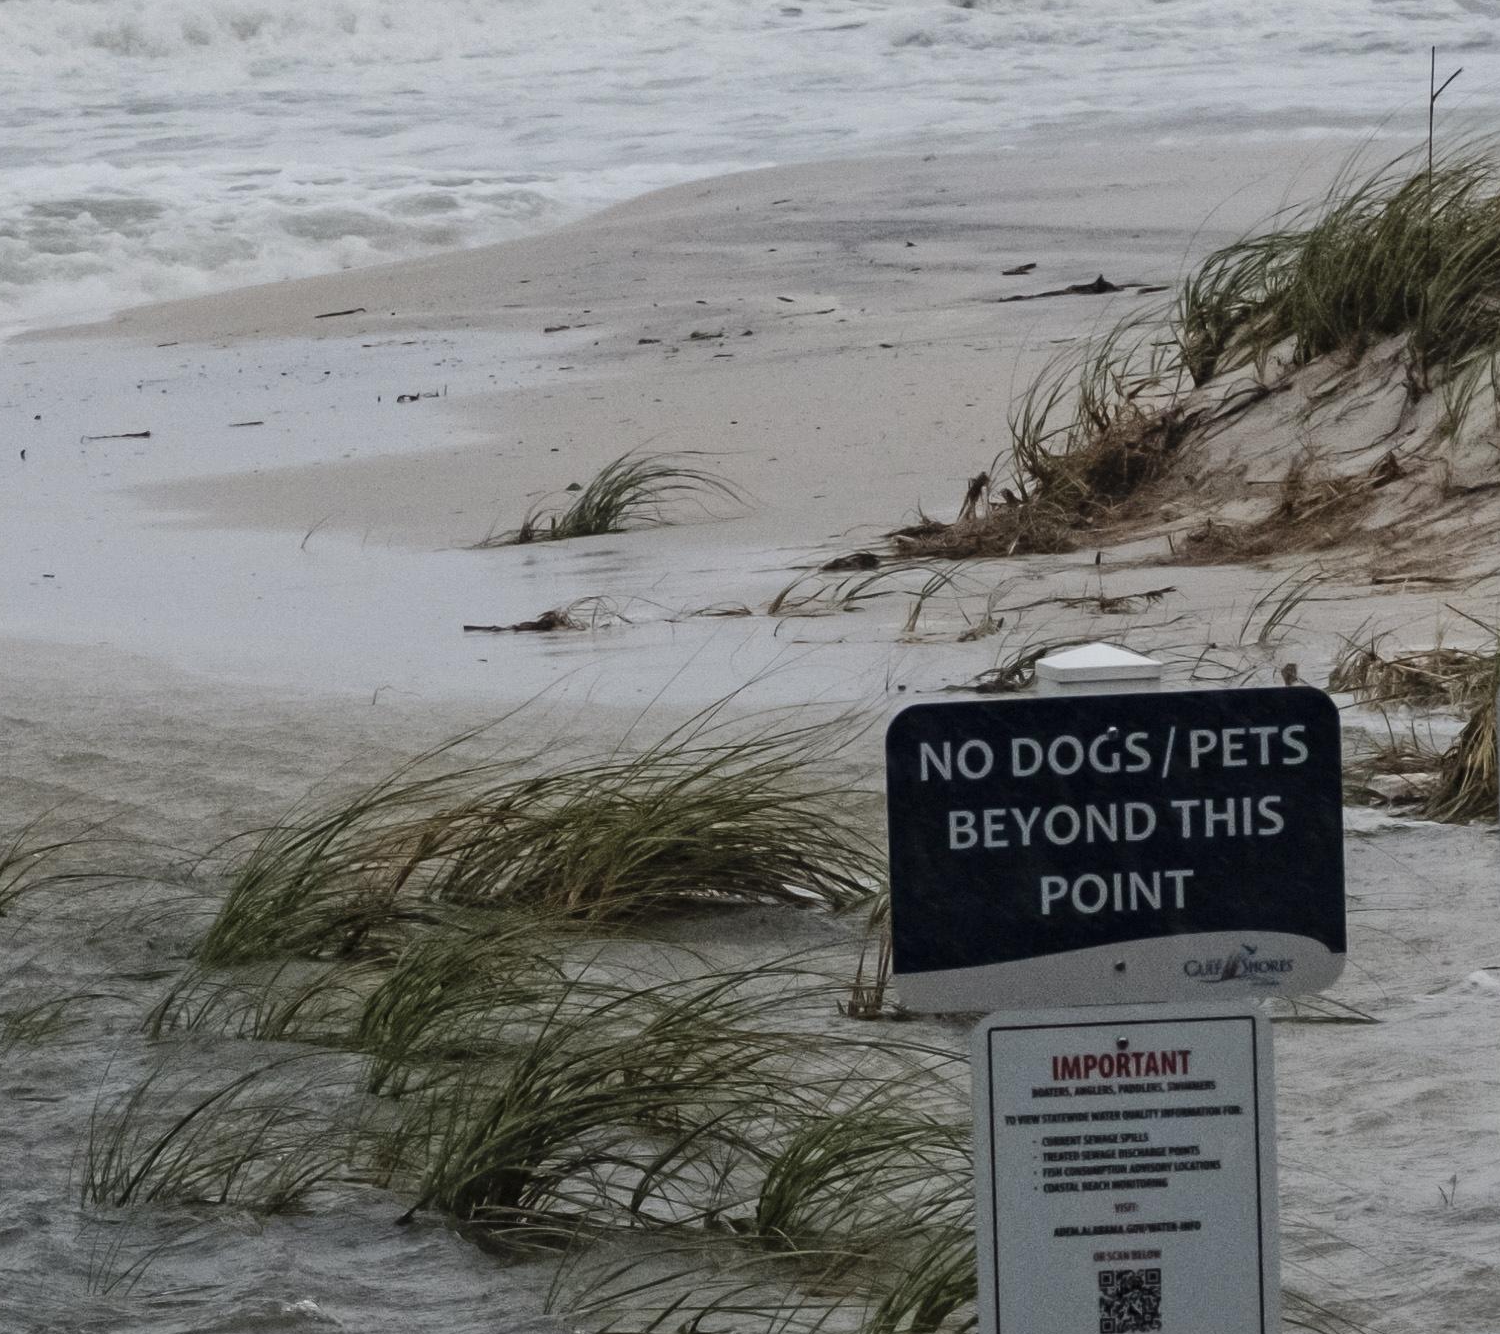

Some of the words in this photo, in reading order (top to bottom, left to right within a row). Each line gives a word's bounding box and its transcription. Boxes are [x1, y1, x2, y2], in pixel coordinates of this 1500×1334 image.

[920, 739, 994, 782] NO
[949, 802, 1156, 850] BEYOND
[1171, 795, 1284, 839] THIS
[1041, 869, 1194, 915] POINT
[1052, 1050, 1192, 1081] IMPORTANT
